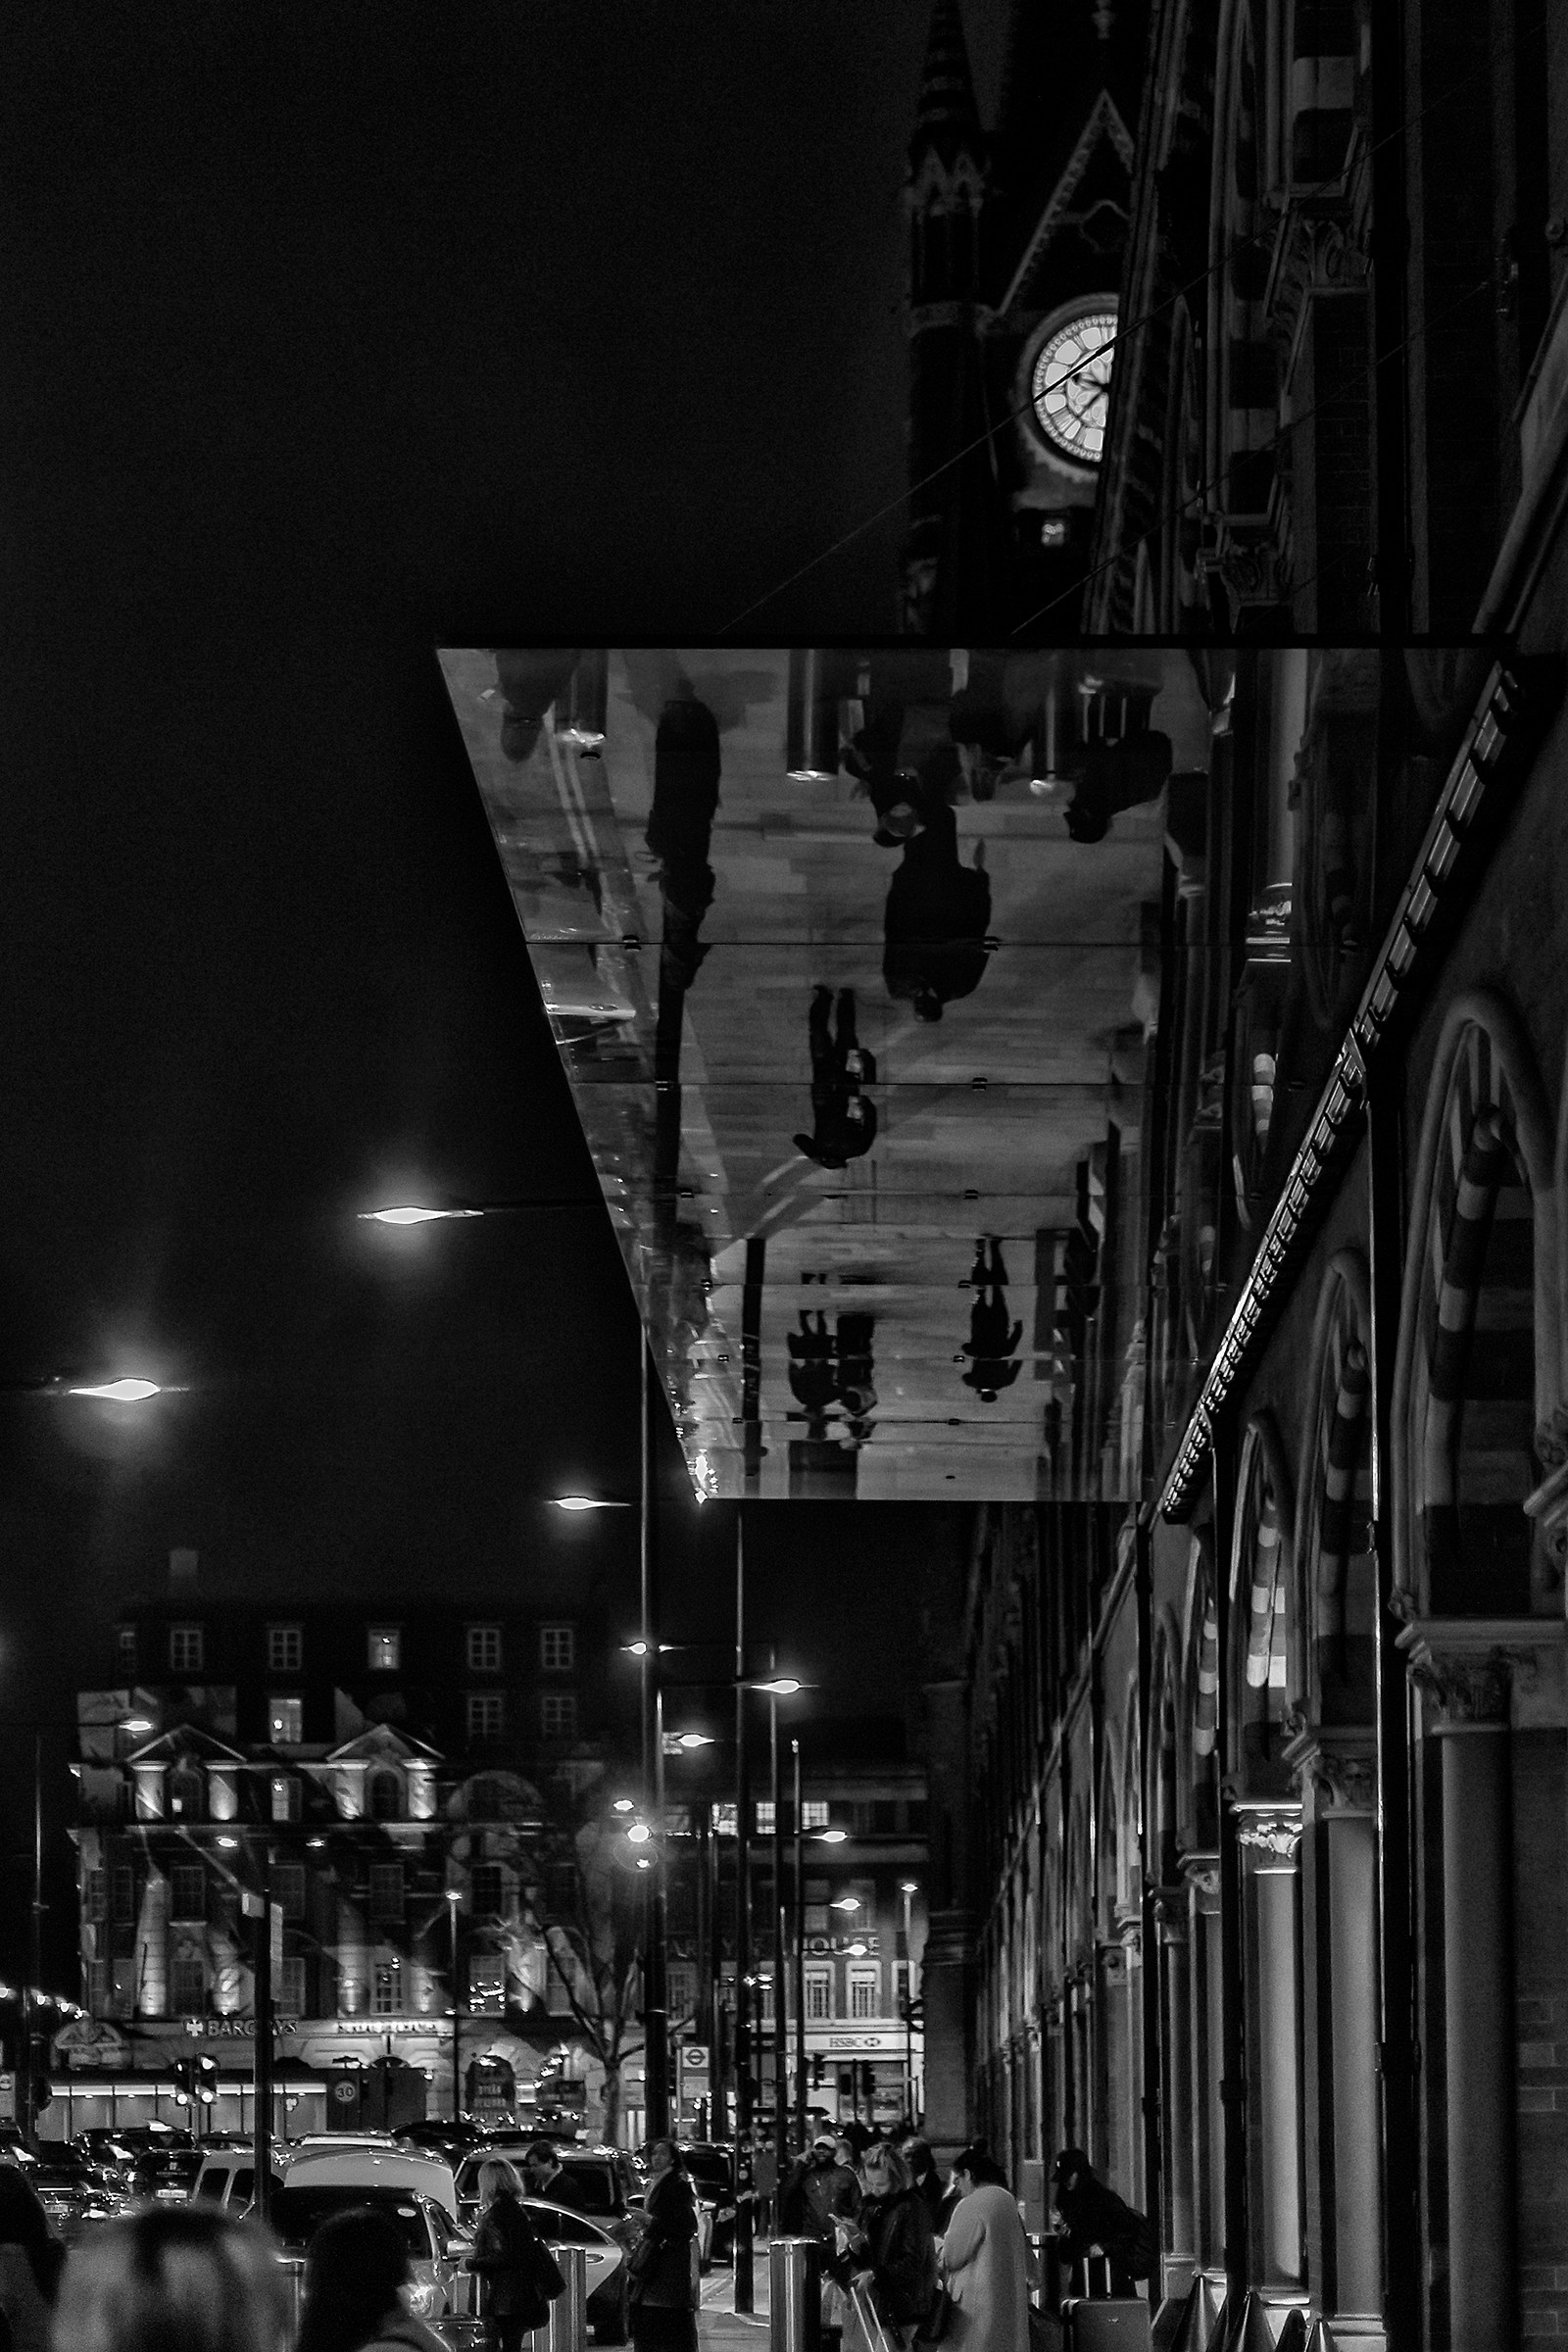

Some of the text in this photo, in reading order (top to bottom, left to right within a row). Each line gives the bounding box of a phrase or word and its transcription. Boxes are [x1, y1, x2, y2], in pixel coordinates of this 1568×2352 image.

[207, 2019, 299, 2036] BARCYS
[829, 2037, 862, 2048] HSBC
[337, 2086, 354, 2098] 30
